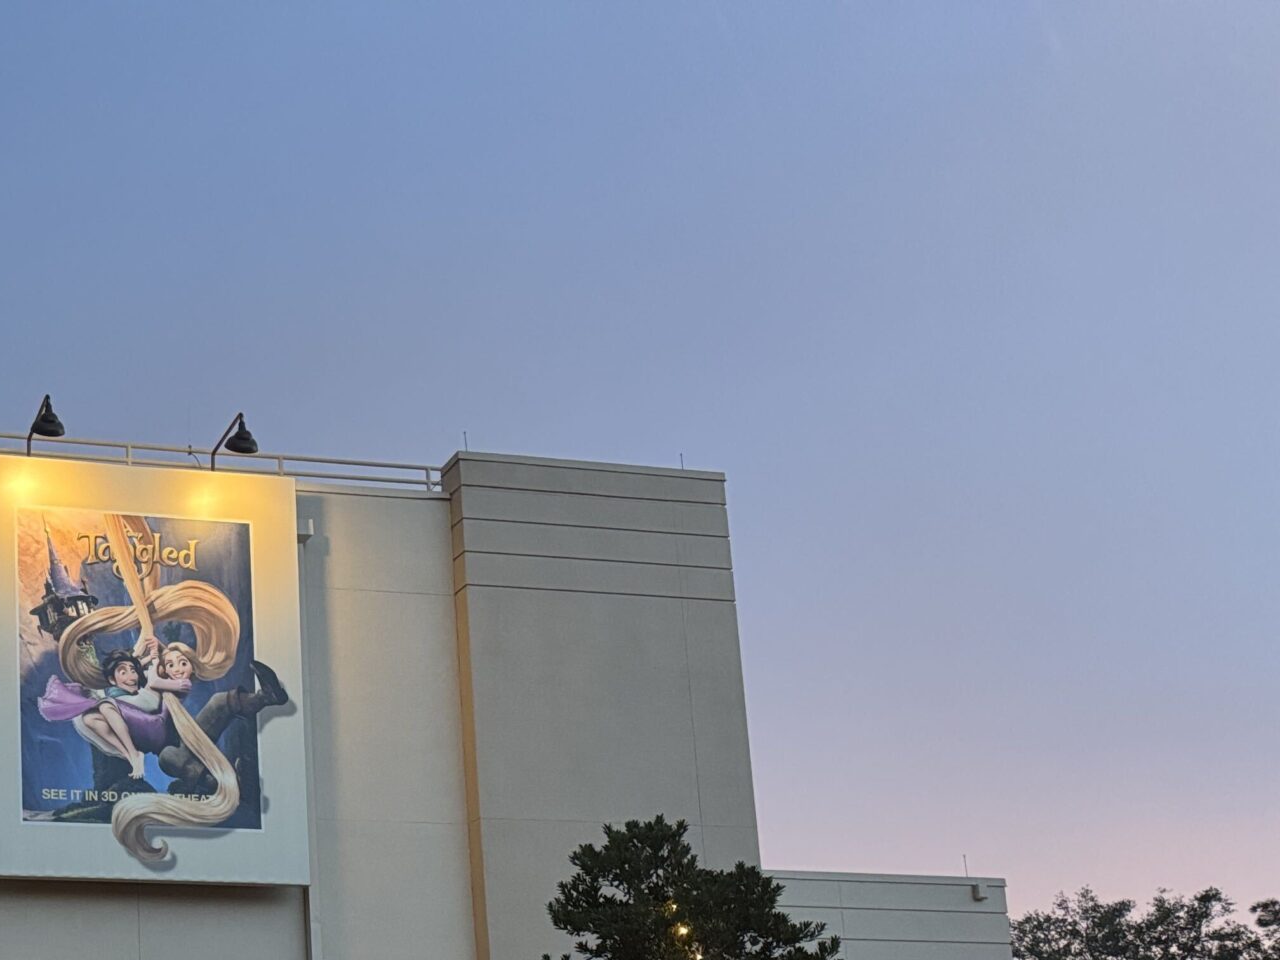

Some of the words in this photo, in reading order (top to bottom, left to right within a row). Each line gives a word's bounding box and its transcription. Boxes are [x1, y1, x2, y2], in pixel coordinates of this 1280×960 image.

[77, 531, 199, 580] Tagled
[41, 788, 67, 800] SEE
[70, 789, 82, 800] IT
[85, 790, 98, 801] IN
[101, 790, 118, 802] 3D
